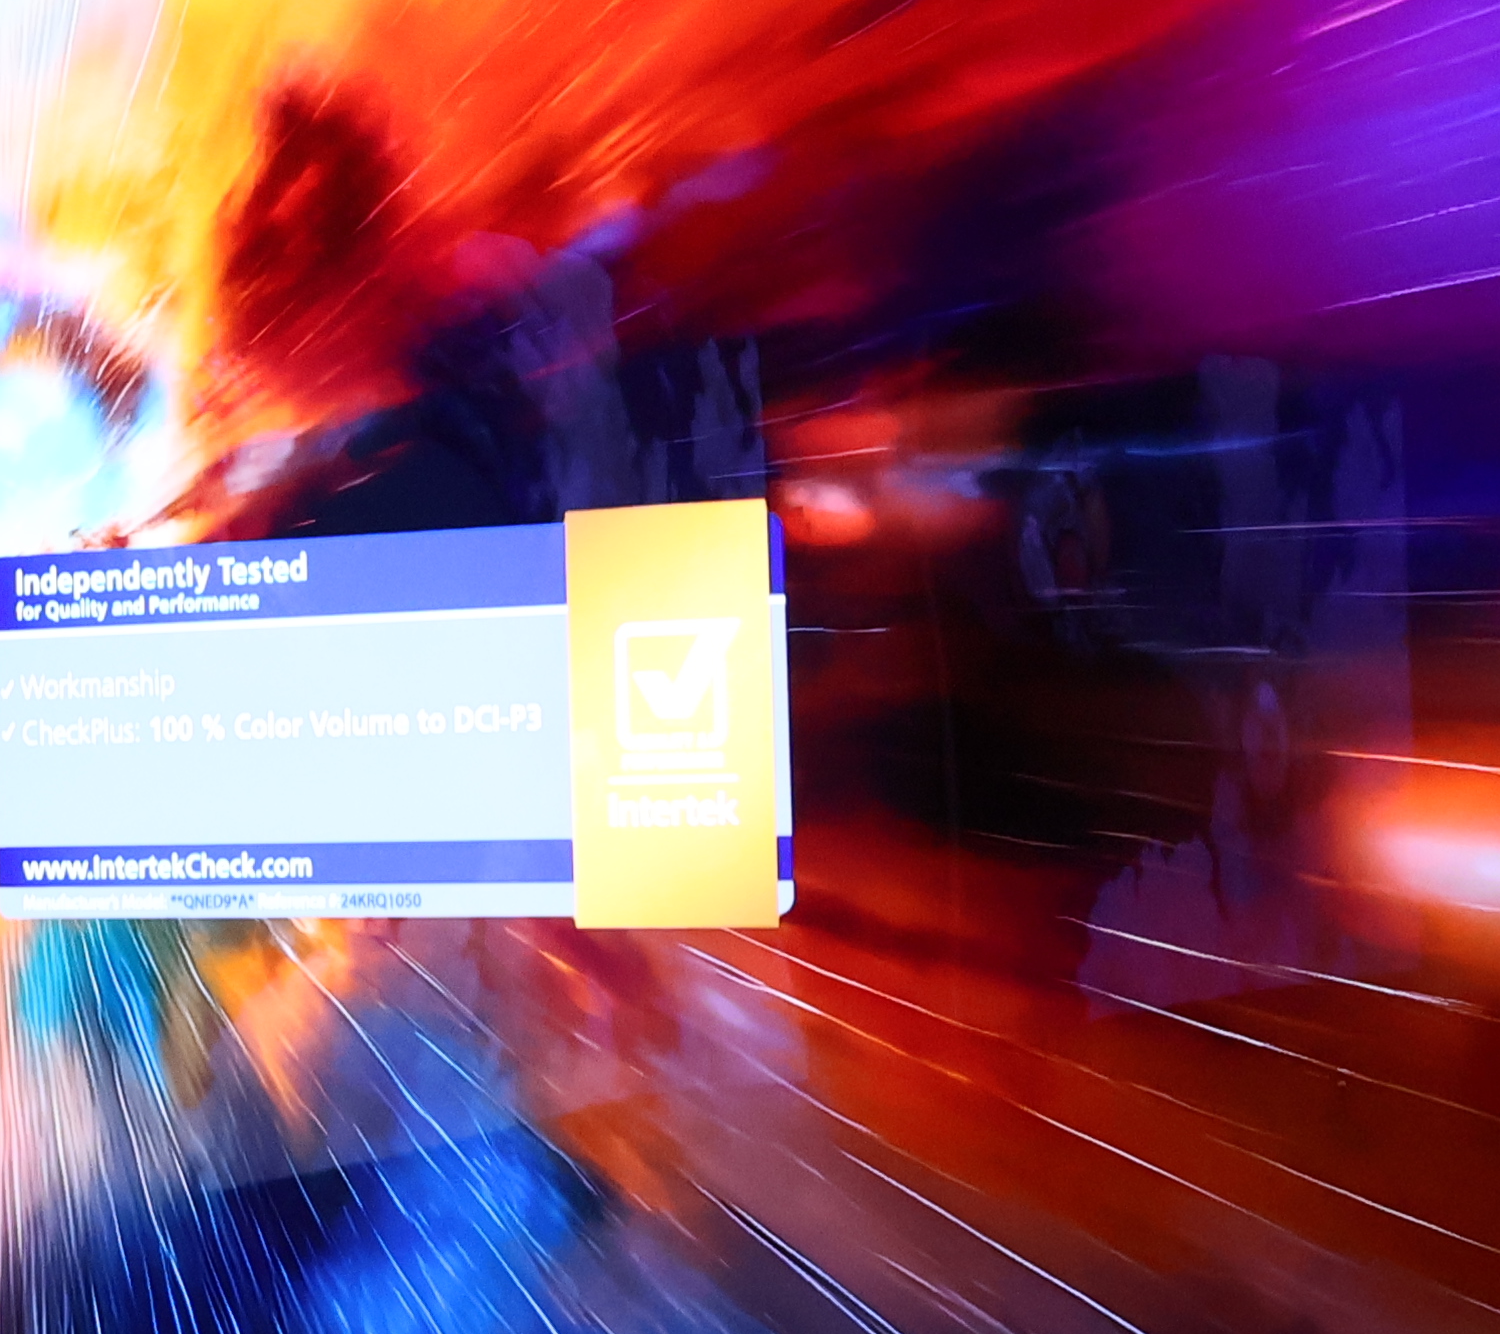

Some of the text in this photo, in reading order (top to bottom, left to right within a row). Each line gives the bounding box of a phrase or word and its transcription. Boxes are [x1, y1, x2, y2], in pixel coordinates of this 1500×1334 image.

[16, 551, 307, 598] Independently Tested
[16, 592, 259, 621] for Quality and Performance
[21, 669, 175, 701] Workmanship
[23, 718, 140, 746] CheckPlus:
[150, 715, 193, 742] 100
[235, 711, 303, 740] Color
[310, 708, 409, 737] Volume
[417, 709, 446, 734] to
[455, 703, 541, 733] DCI-P3
[23, 851, 312, 880] www.IntertekCheck.com
